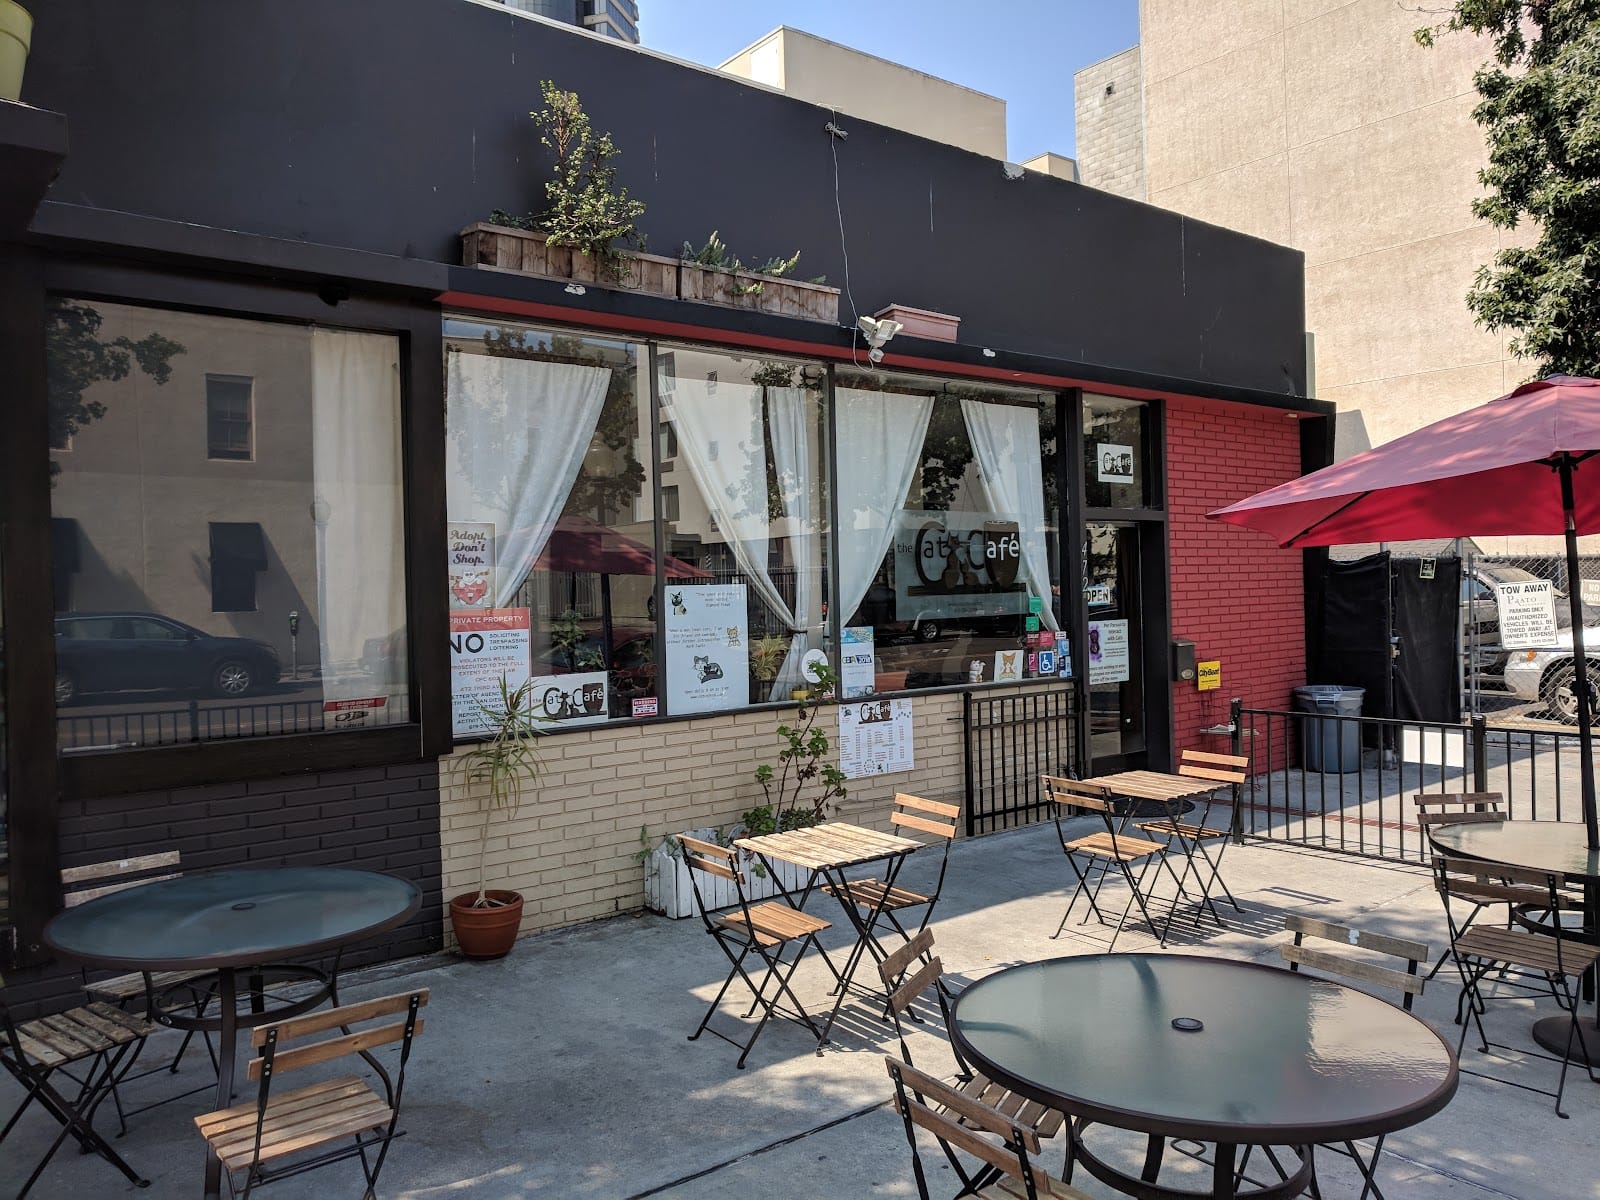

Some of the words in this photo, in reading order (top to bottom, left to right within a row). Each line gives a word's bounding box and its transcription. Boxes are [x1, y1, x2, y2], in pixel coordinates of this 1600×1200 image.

[450, 529, 487, 543] Adopt.
[452, 541, 485, 552] Don't
[897, 542, 913, 553] the
[914, 520, 950, 586] Cat
[968, 529, 1020, 570] Café
[453, 553, 484, 566] Shop.
[1500, 585, 1520, 595] TOW
[1524, 583, 1548, 593] AWAY
[482, 615, 523, 623] PROPERTY
[450, 633, 485, 654] NO
[543, 687, 562, 719] Cat
[572, 687, 604, 707] Café
